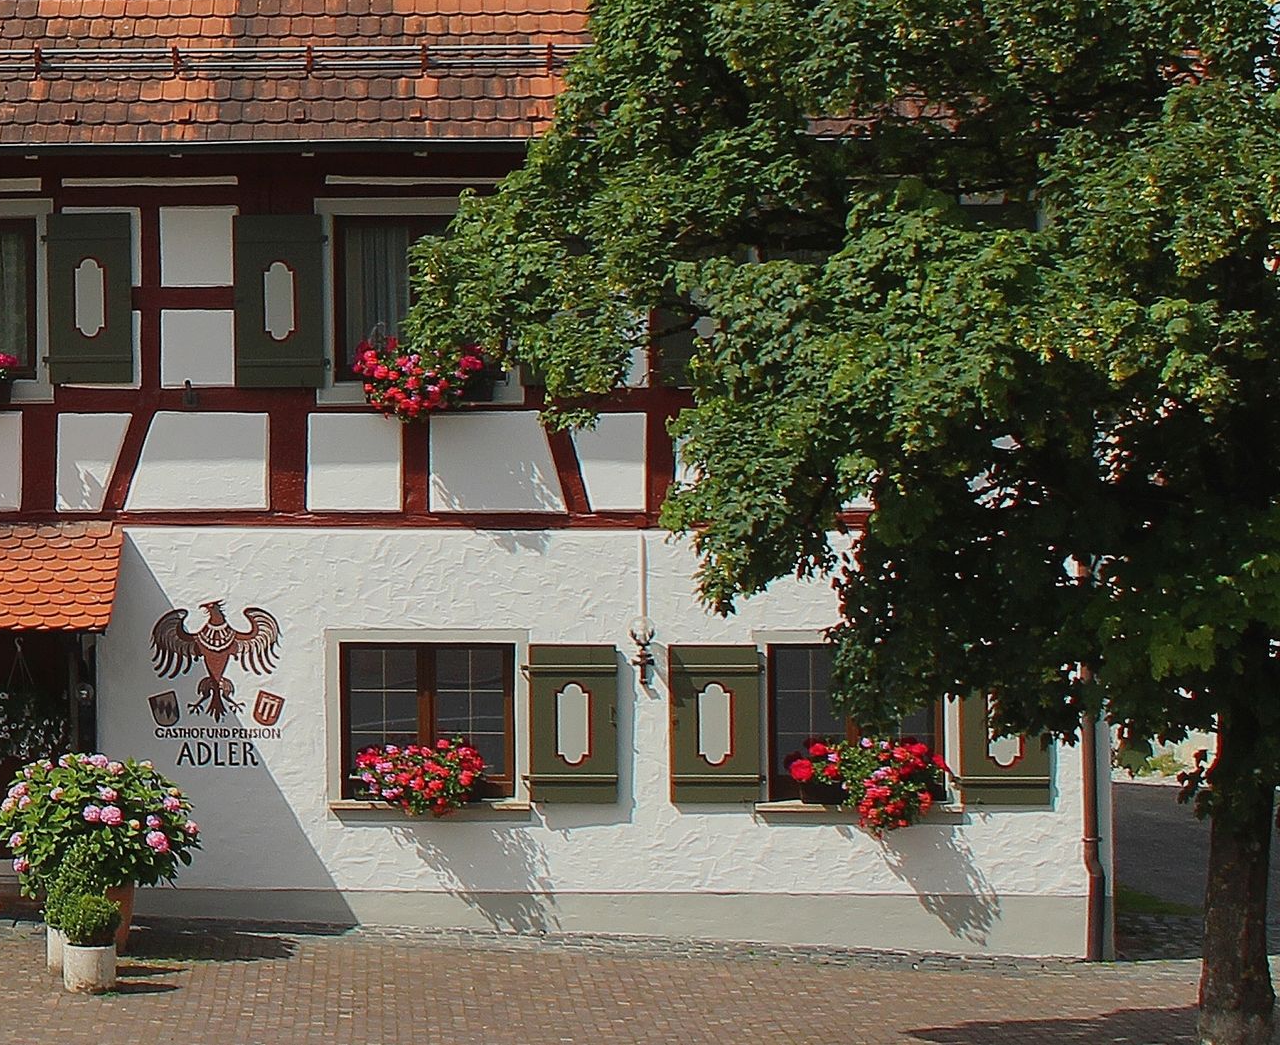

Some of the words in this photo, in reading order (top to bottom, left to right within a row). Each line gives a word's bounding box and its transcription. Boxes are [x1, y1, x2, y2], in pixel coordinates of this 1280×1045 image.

[155, 728, 206, 739] GASTHOF
[207, 728, 230, 739] UND
[232, 728, 281, 739] PENSION
[176, 741, 259, 767] ADLER
